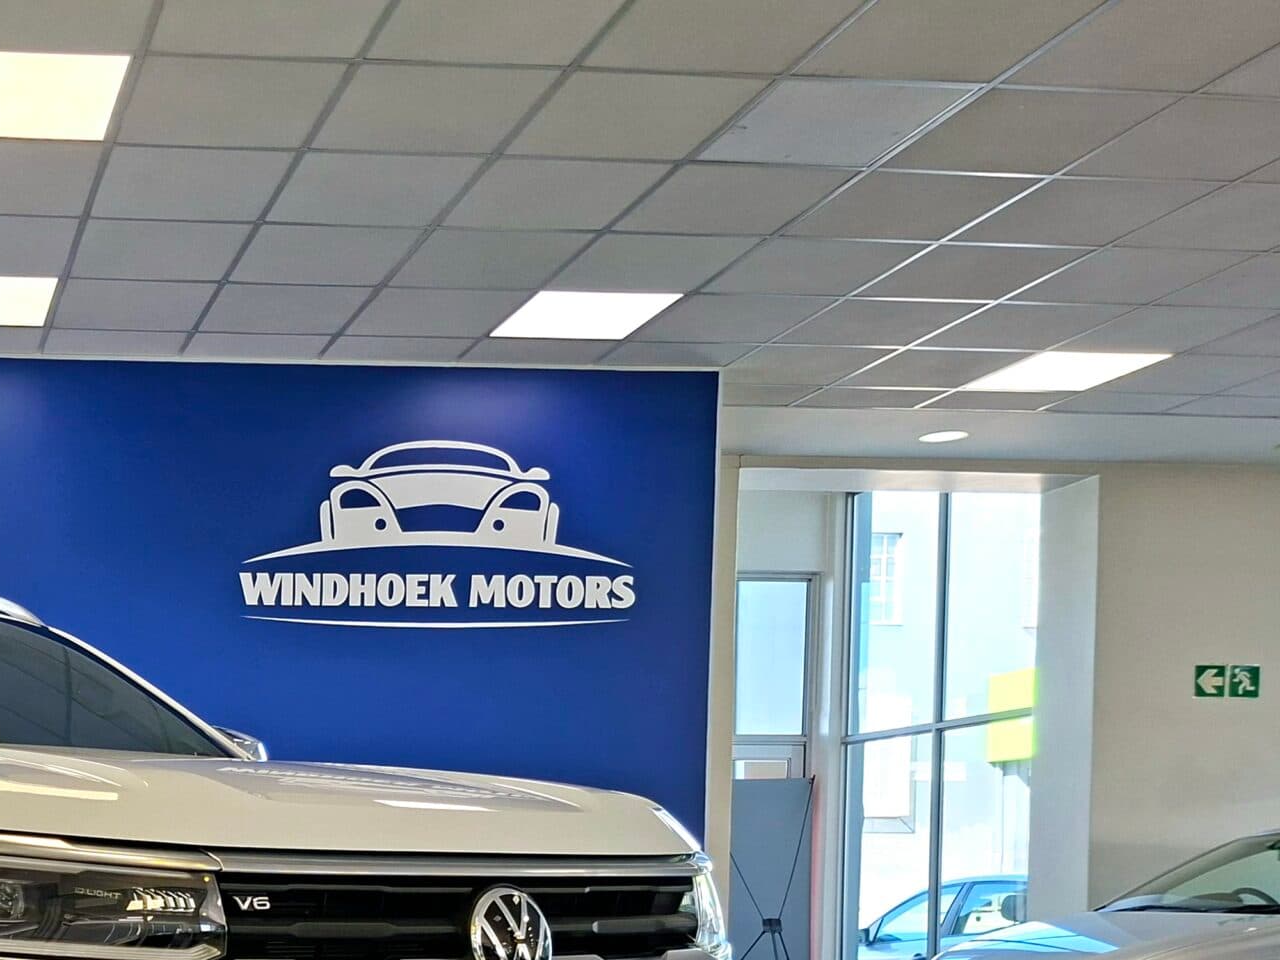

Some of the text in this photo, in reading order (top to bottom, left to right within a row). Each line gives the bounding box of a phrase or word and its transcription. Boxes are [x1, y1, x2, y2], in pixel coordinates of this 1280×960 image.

[239, 572, 635, 609] WINDHOEK MOTORS
[232, 895, 272, 912] V6
